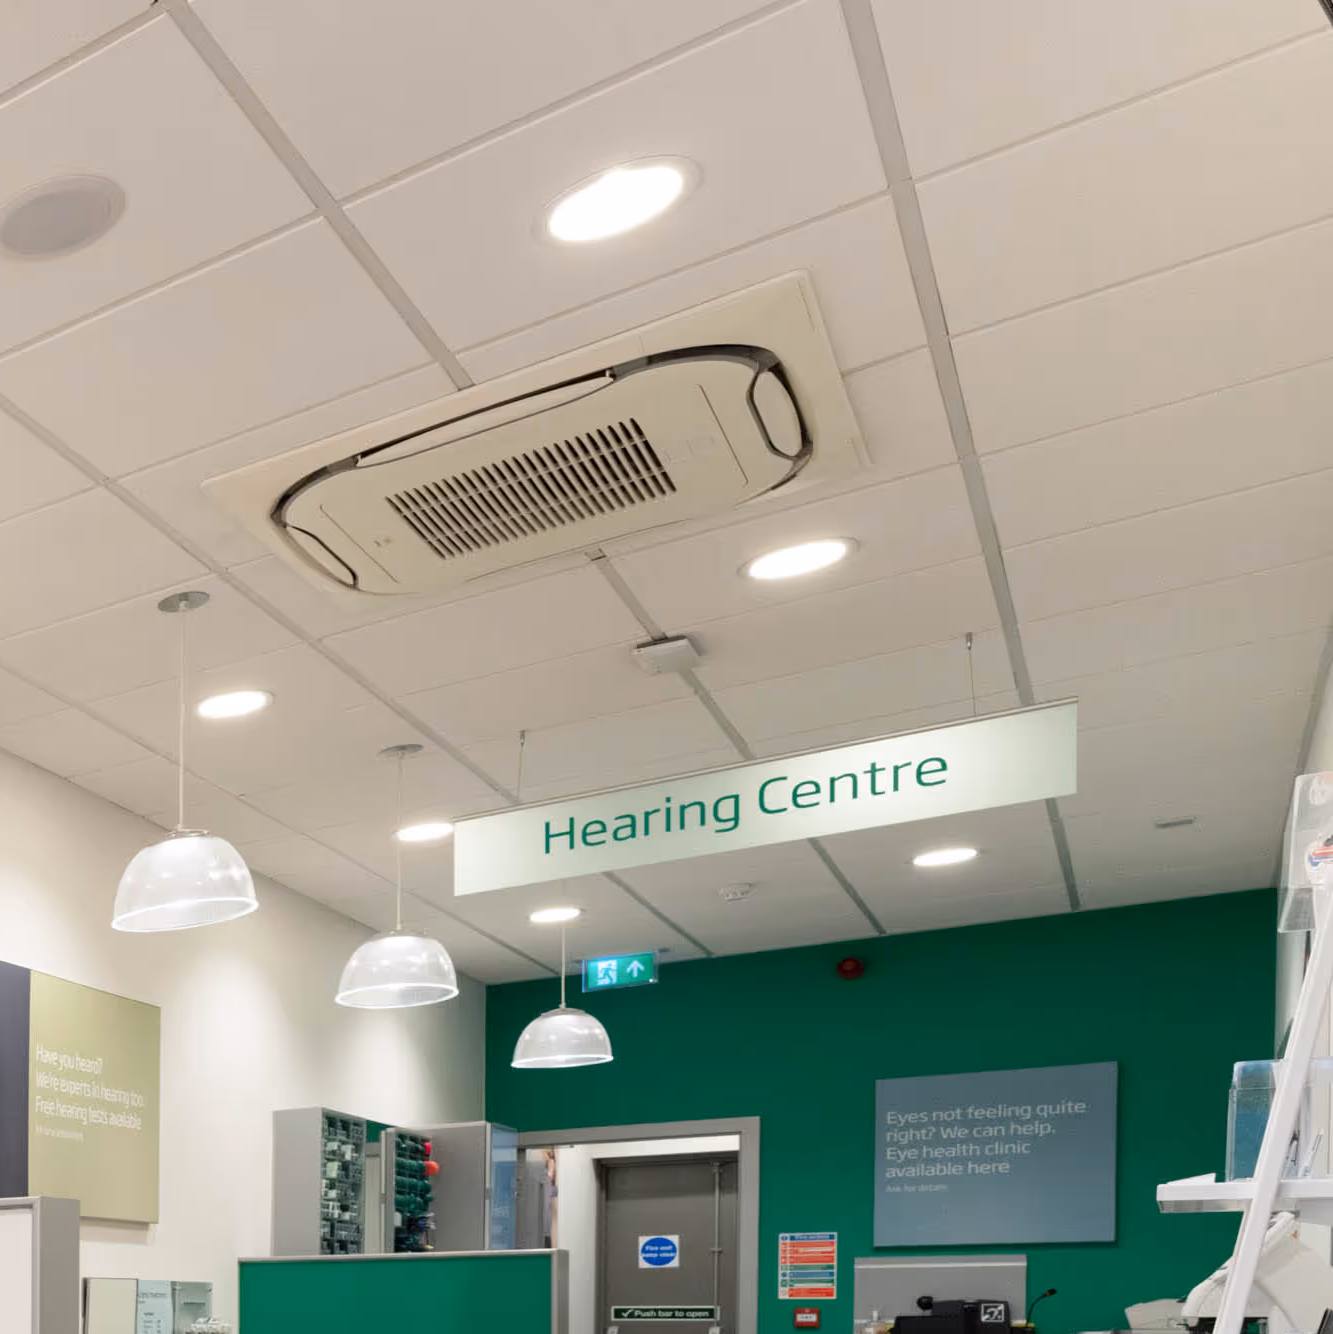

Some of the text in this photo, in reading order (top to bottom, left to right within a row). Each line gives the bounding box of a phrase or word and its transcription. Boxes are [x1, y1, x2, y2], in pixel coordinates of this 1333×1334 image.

[544, 756, 949, 854] Hearing Centre
[36, 1042, 102, 1075] Have you heard?
[36, 1072, 59, 1091] We're
[60, 1079, 91, 1097] experts
[101, 1084, 129, 1109] hearing
[35, 1096, 54, 1115] Free
[55, 1098, 87, 1125] hearing
[109, 1112, 142, 1130] available
[886, 1099, 1086, 1127] Eyes not feeling quite
[886, 1121, 1056, 1144] right? We can help.
[886, 1141, 1031, 1163] Eye health clinic
[885, 1161, 1010, 1178] available here
[686, 1311, 709, 1319] open
